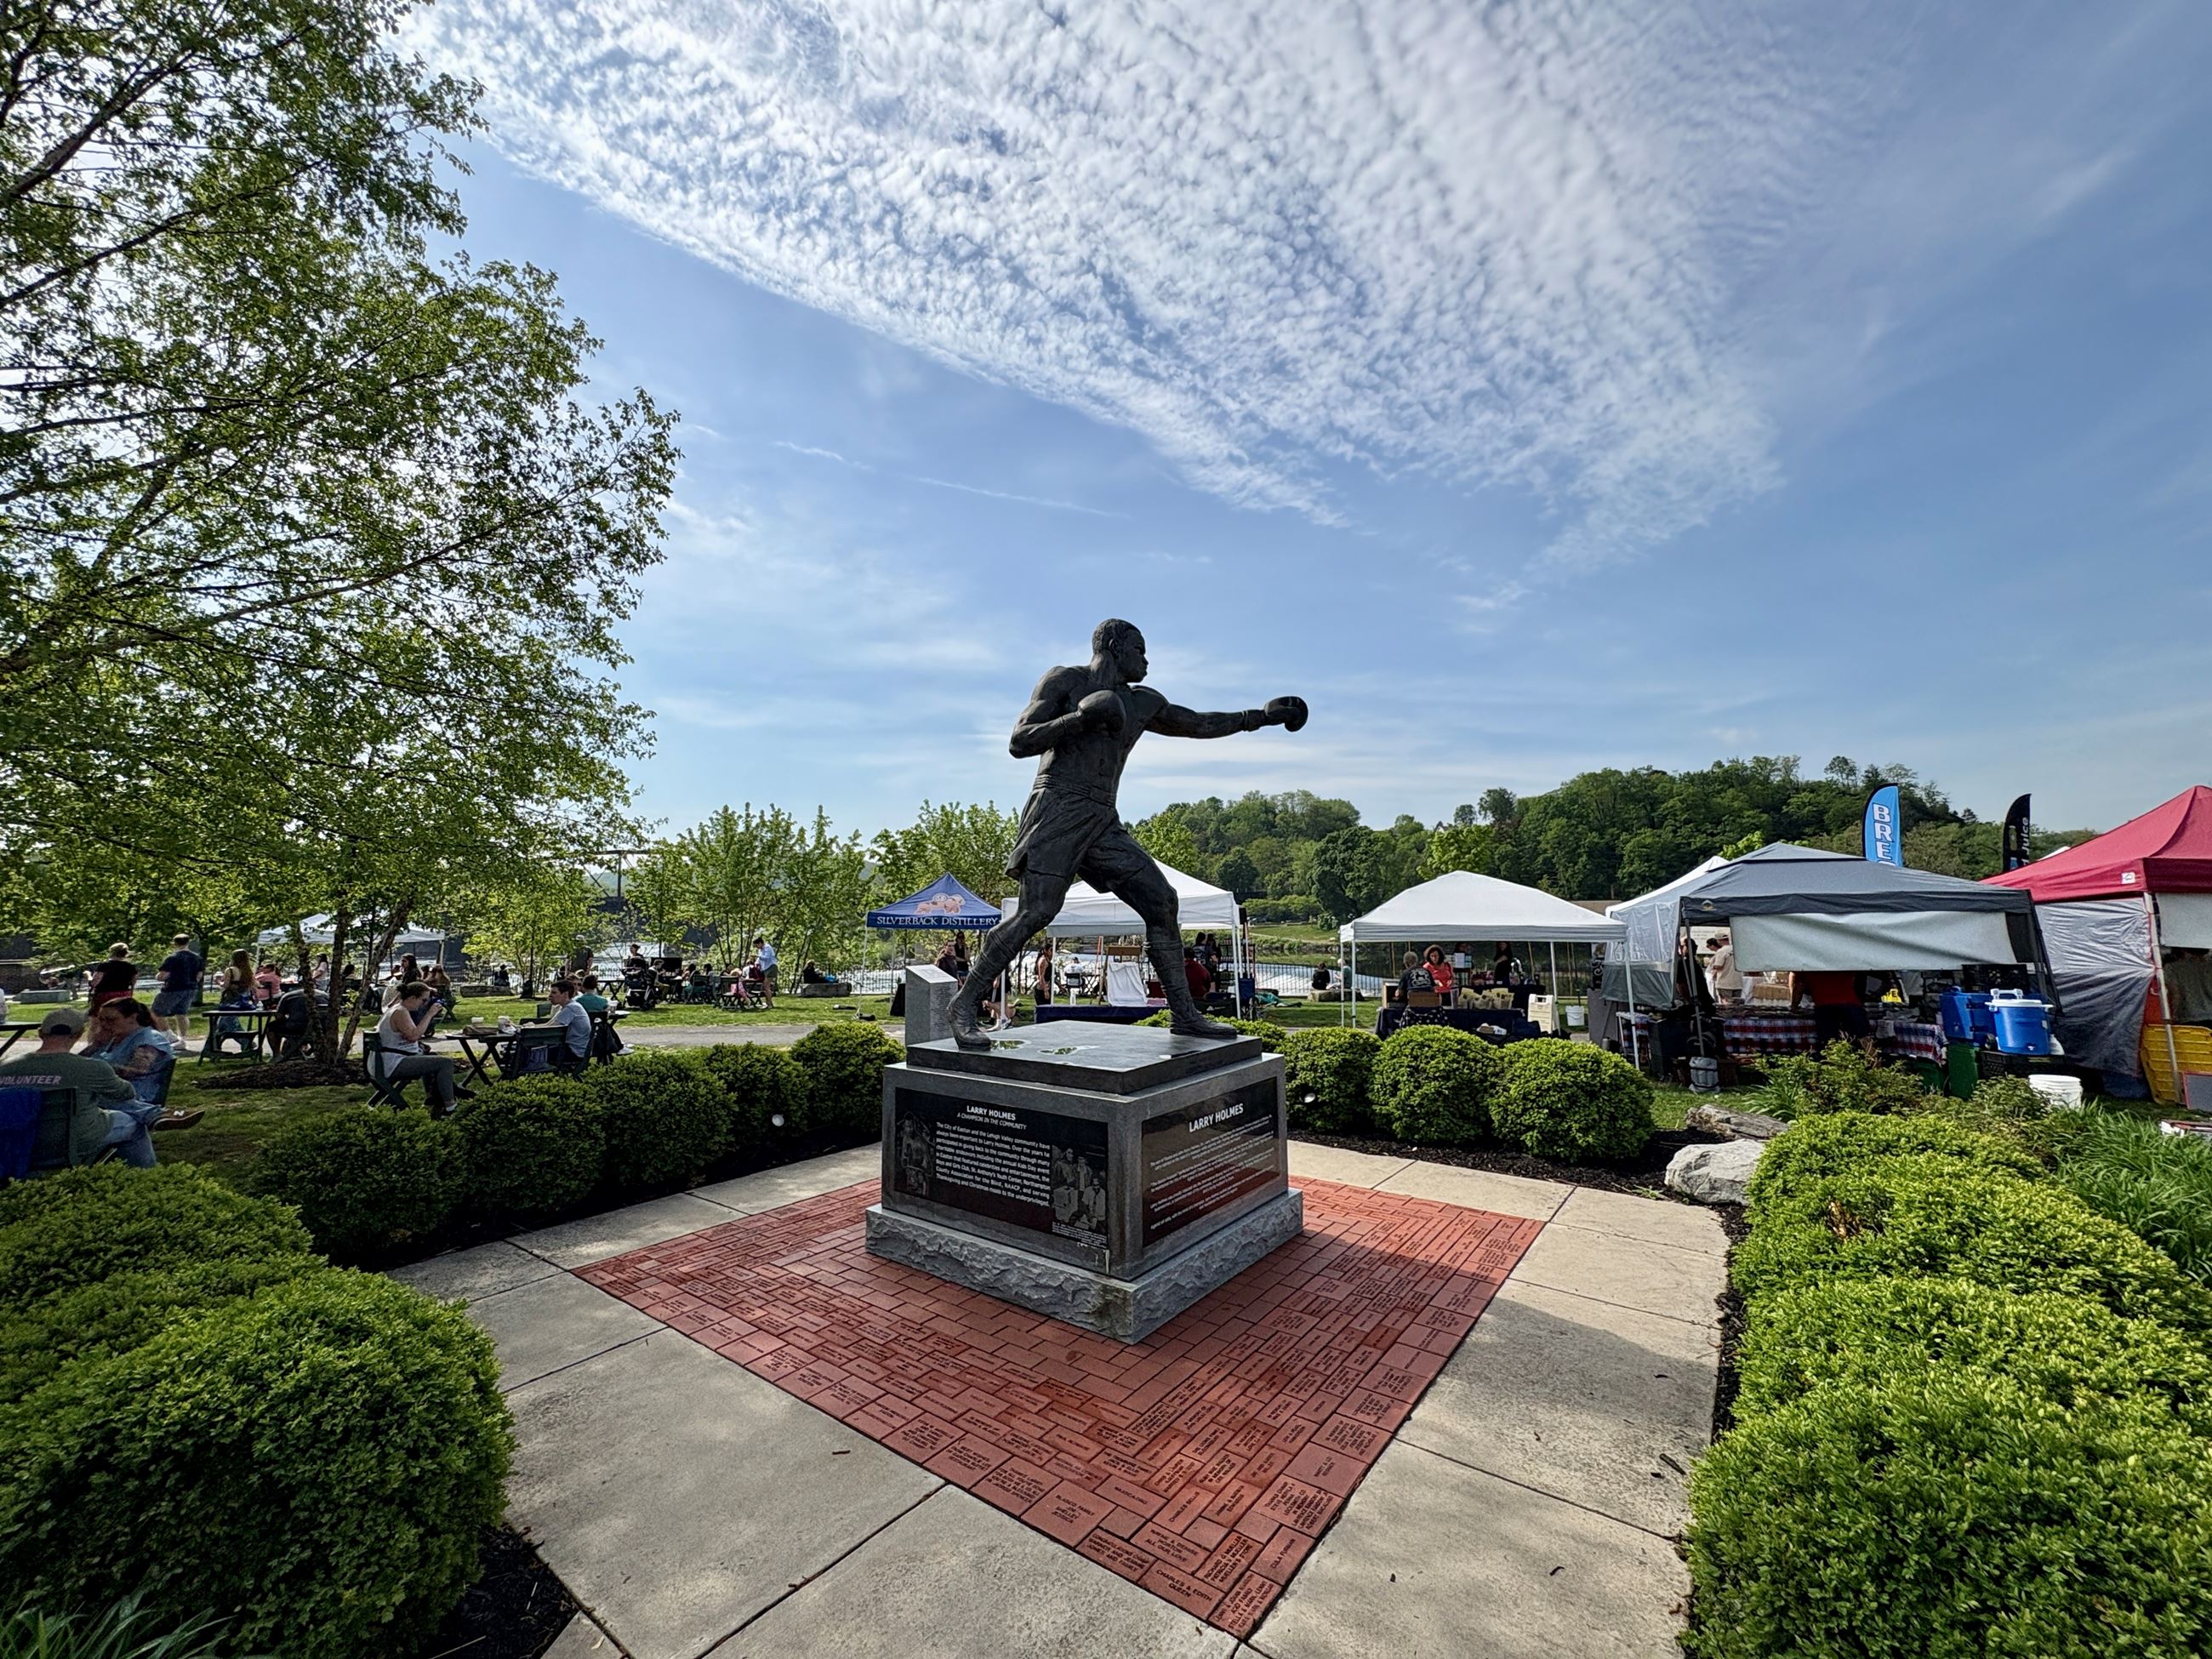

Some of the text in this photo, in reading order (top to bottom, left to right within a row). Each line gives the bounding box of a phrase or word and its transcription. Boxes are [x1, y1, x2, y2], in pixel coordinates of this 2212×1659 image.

[876, 915, 998, 926] SILVERBACK DISTILLERY
[0, 1075, 62, 1085] VOLUNTEER
[966, 1105, 1016, 1120] LARRY HOLMES
[1189, 1103, 1244, 1132] LARRY HOLMES
[1143, 1538, 1158, 1548] ALL
[1155, 1569, 1185, 1588] CHARLES
[1192, 1588, 1213, 1602] EDITH
[1167, 1582, 1193, 1599] QUEEN
